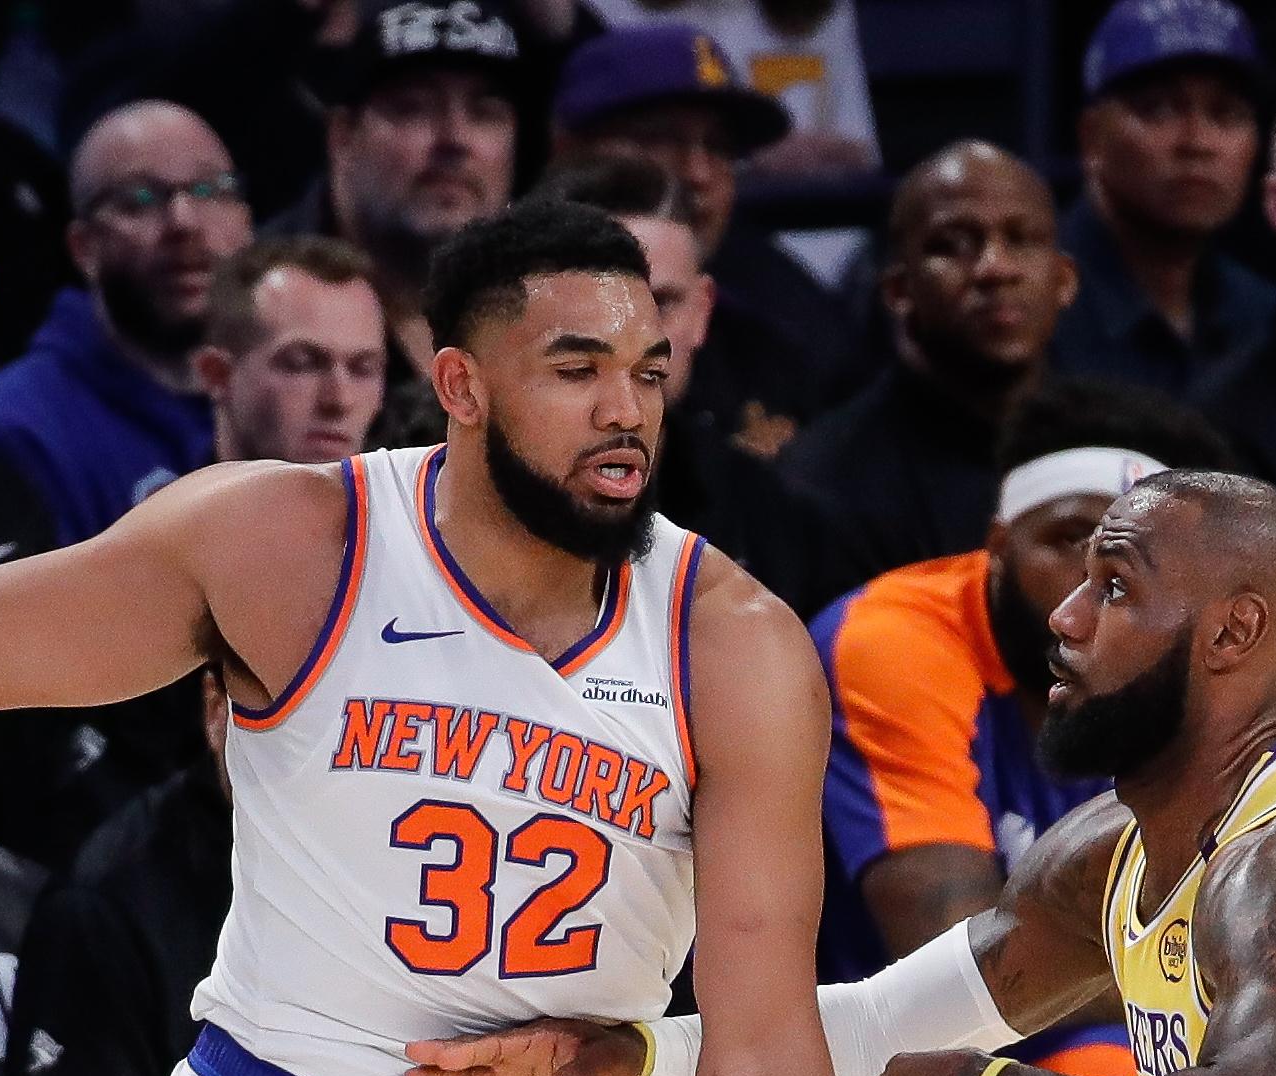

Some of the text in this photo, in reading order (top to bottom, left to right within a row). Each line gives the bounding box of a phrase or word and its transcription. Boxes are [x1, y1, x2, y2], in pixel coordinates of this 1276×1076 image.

[582, 685, 617, 702] abu
[329, 697, 671, 841] NEW YORK
[384, 798, 614, 980] 32
